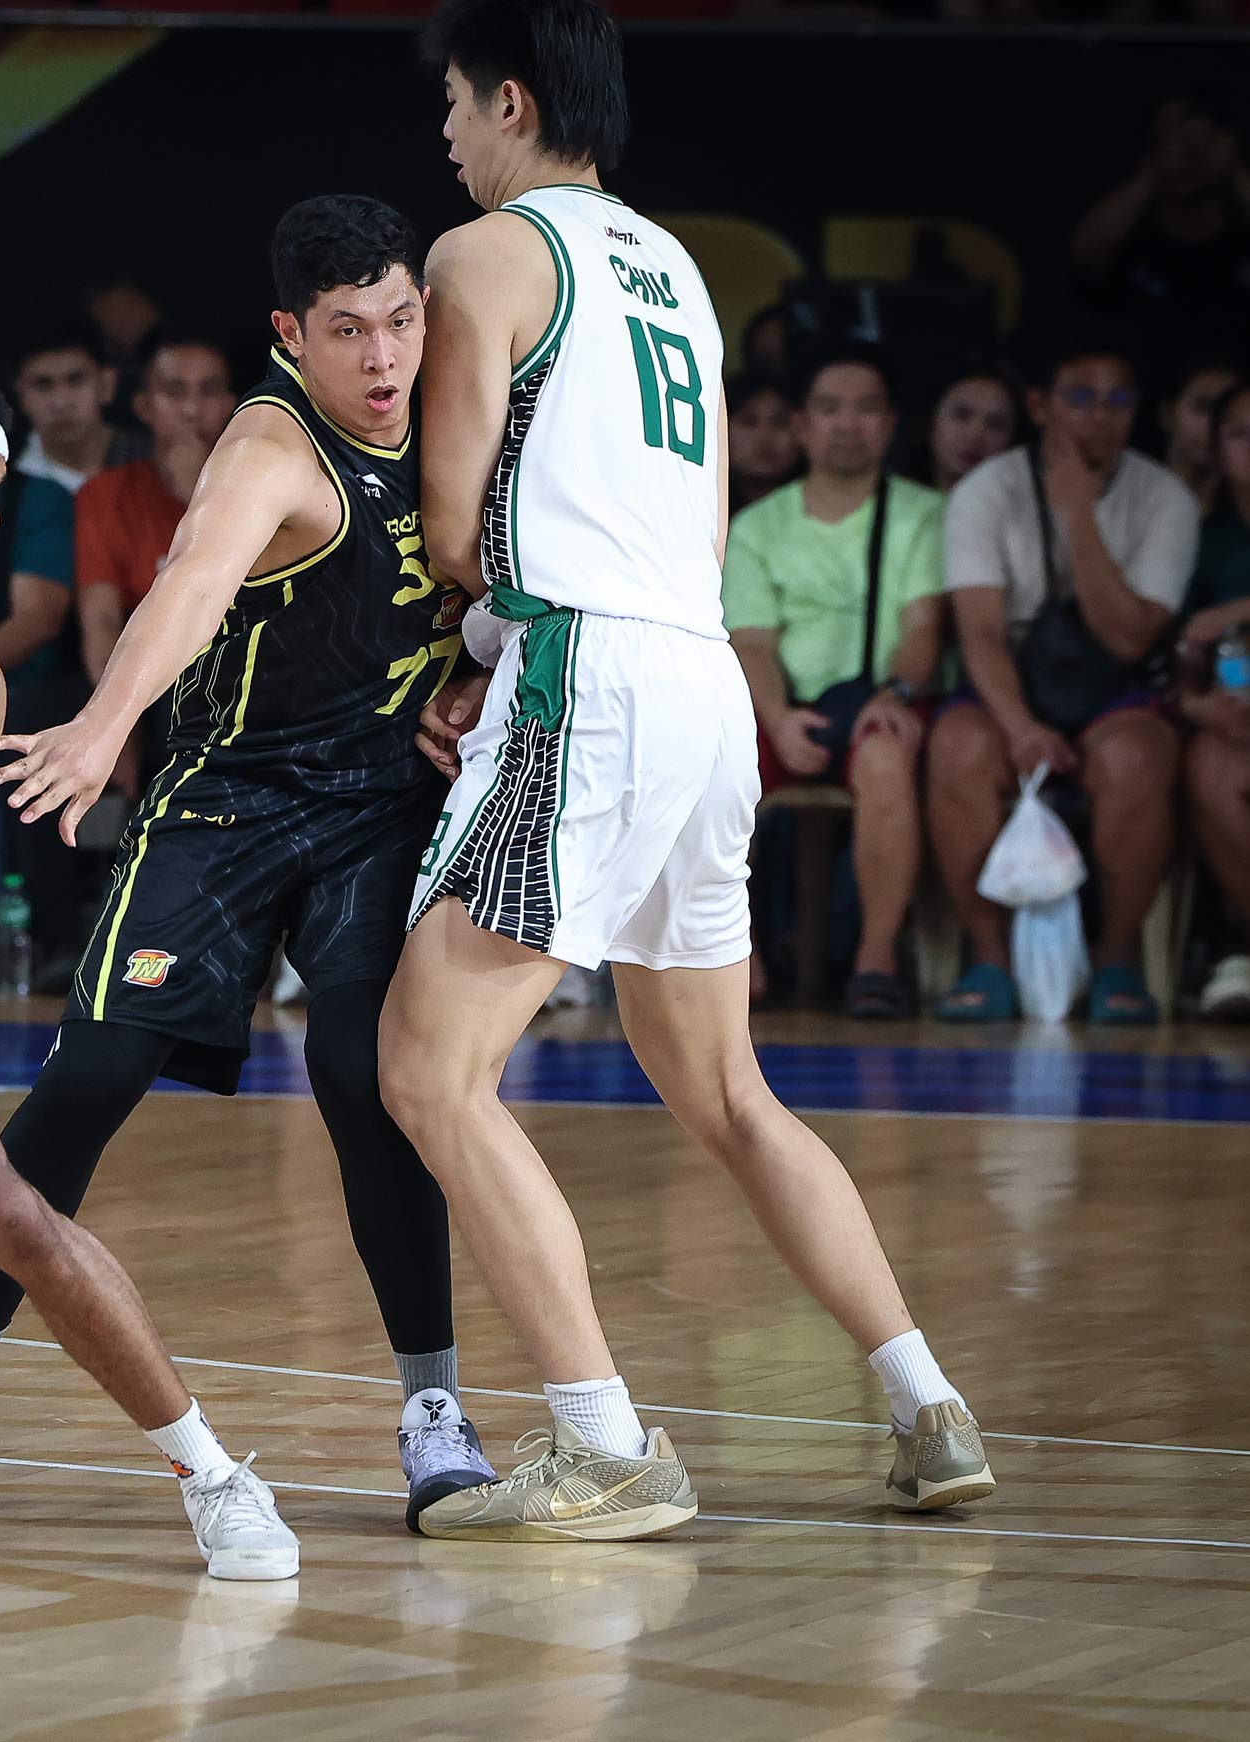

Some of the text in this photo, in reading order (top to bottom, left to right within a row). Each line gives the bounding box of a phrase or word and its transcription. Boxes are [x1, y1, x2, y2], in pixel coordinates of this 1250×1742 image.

[609, 254, 679, 309] CHIU
[624, 315, 706, 467] 18
[125, 956, 176, 981] TNT
